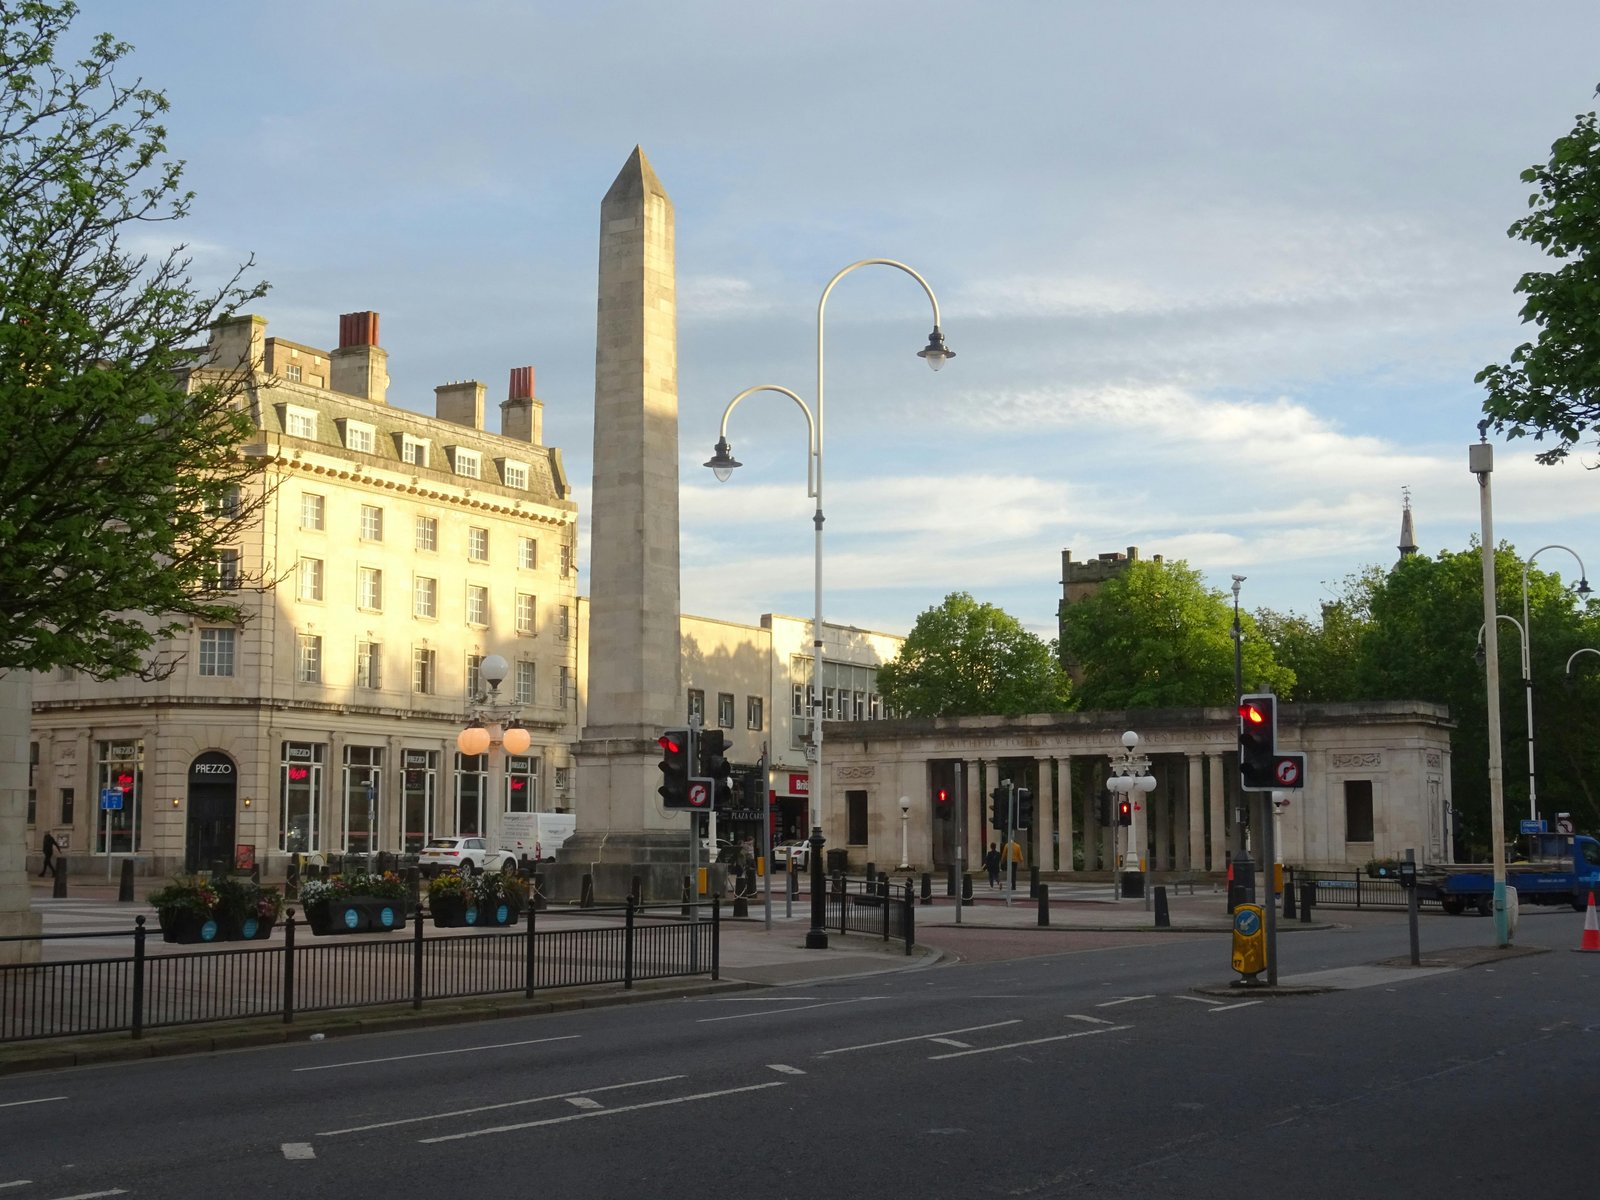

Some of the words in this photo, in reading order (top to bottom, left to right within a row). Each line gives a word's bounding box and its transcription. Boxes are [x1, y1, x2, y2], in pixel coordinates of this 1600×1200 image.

[1056, 734, 1071, 745] WE
[1078, 735, 1104, 745] FELL
[1144, 732, 1176, 743] REST
[195, 763, 232, 774] PREZZO
[731, 812, 748, 820] PLAZA
